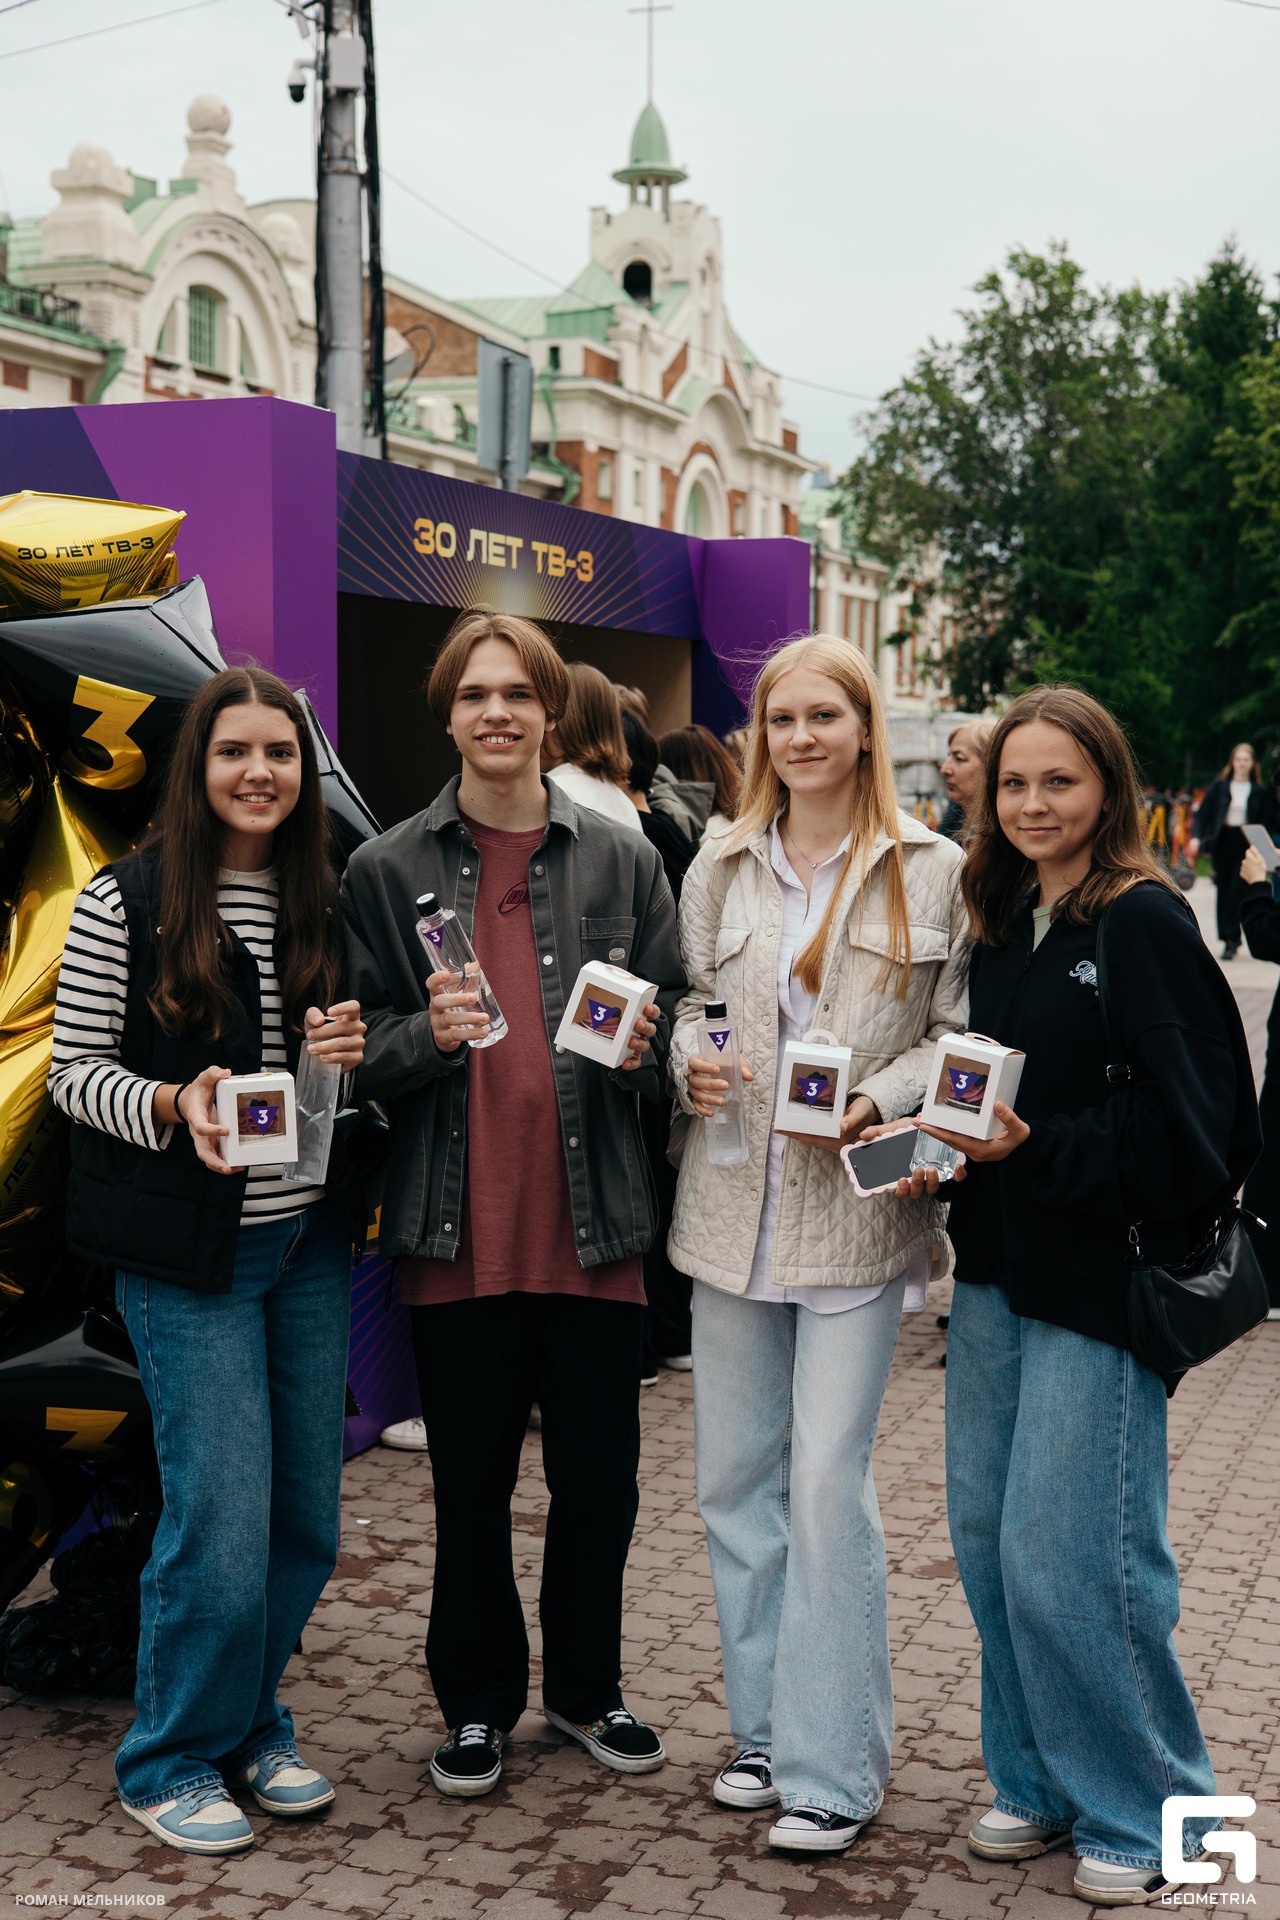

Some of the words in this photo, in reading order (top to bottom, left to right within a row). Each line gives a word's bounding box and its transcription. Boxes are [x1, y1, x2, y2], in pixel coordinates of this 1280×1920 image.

[18, 547, 47, 560] 30
[55, 544, 94, 558] ЛЕТ
[102, 537, 155, 554] ТВ-3
[413, 517, 457, 558] 30
[466, 528, 524, 570] ЛЕТ
[531, 540, 594, 582] ТВ-3
[60, 675, 157, 790] 3
[430, 931, 441, 943] 3
[594, 1006, 607, 1021] 3
[716, 1034, 725, 1046] 3
[806, 1082, 819, 1097] 3
[955, 1074, 969, 1090] 3
[257, 1109, 269, 1125] 3
[3, 1141, 35, 1194] ЛЕТ
